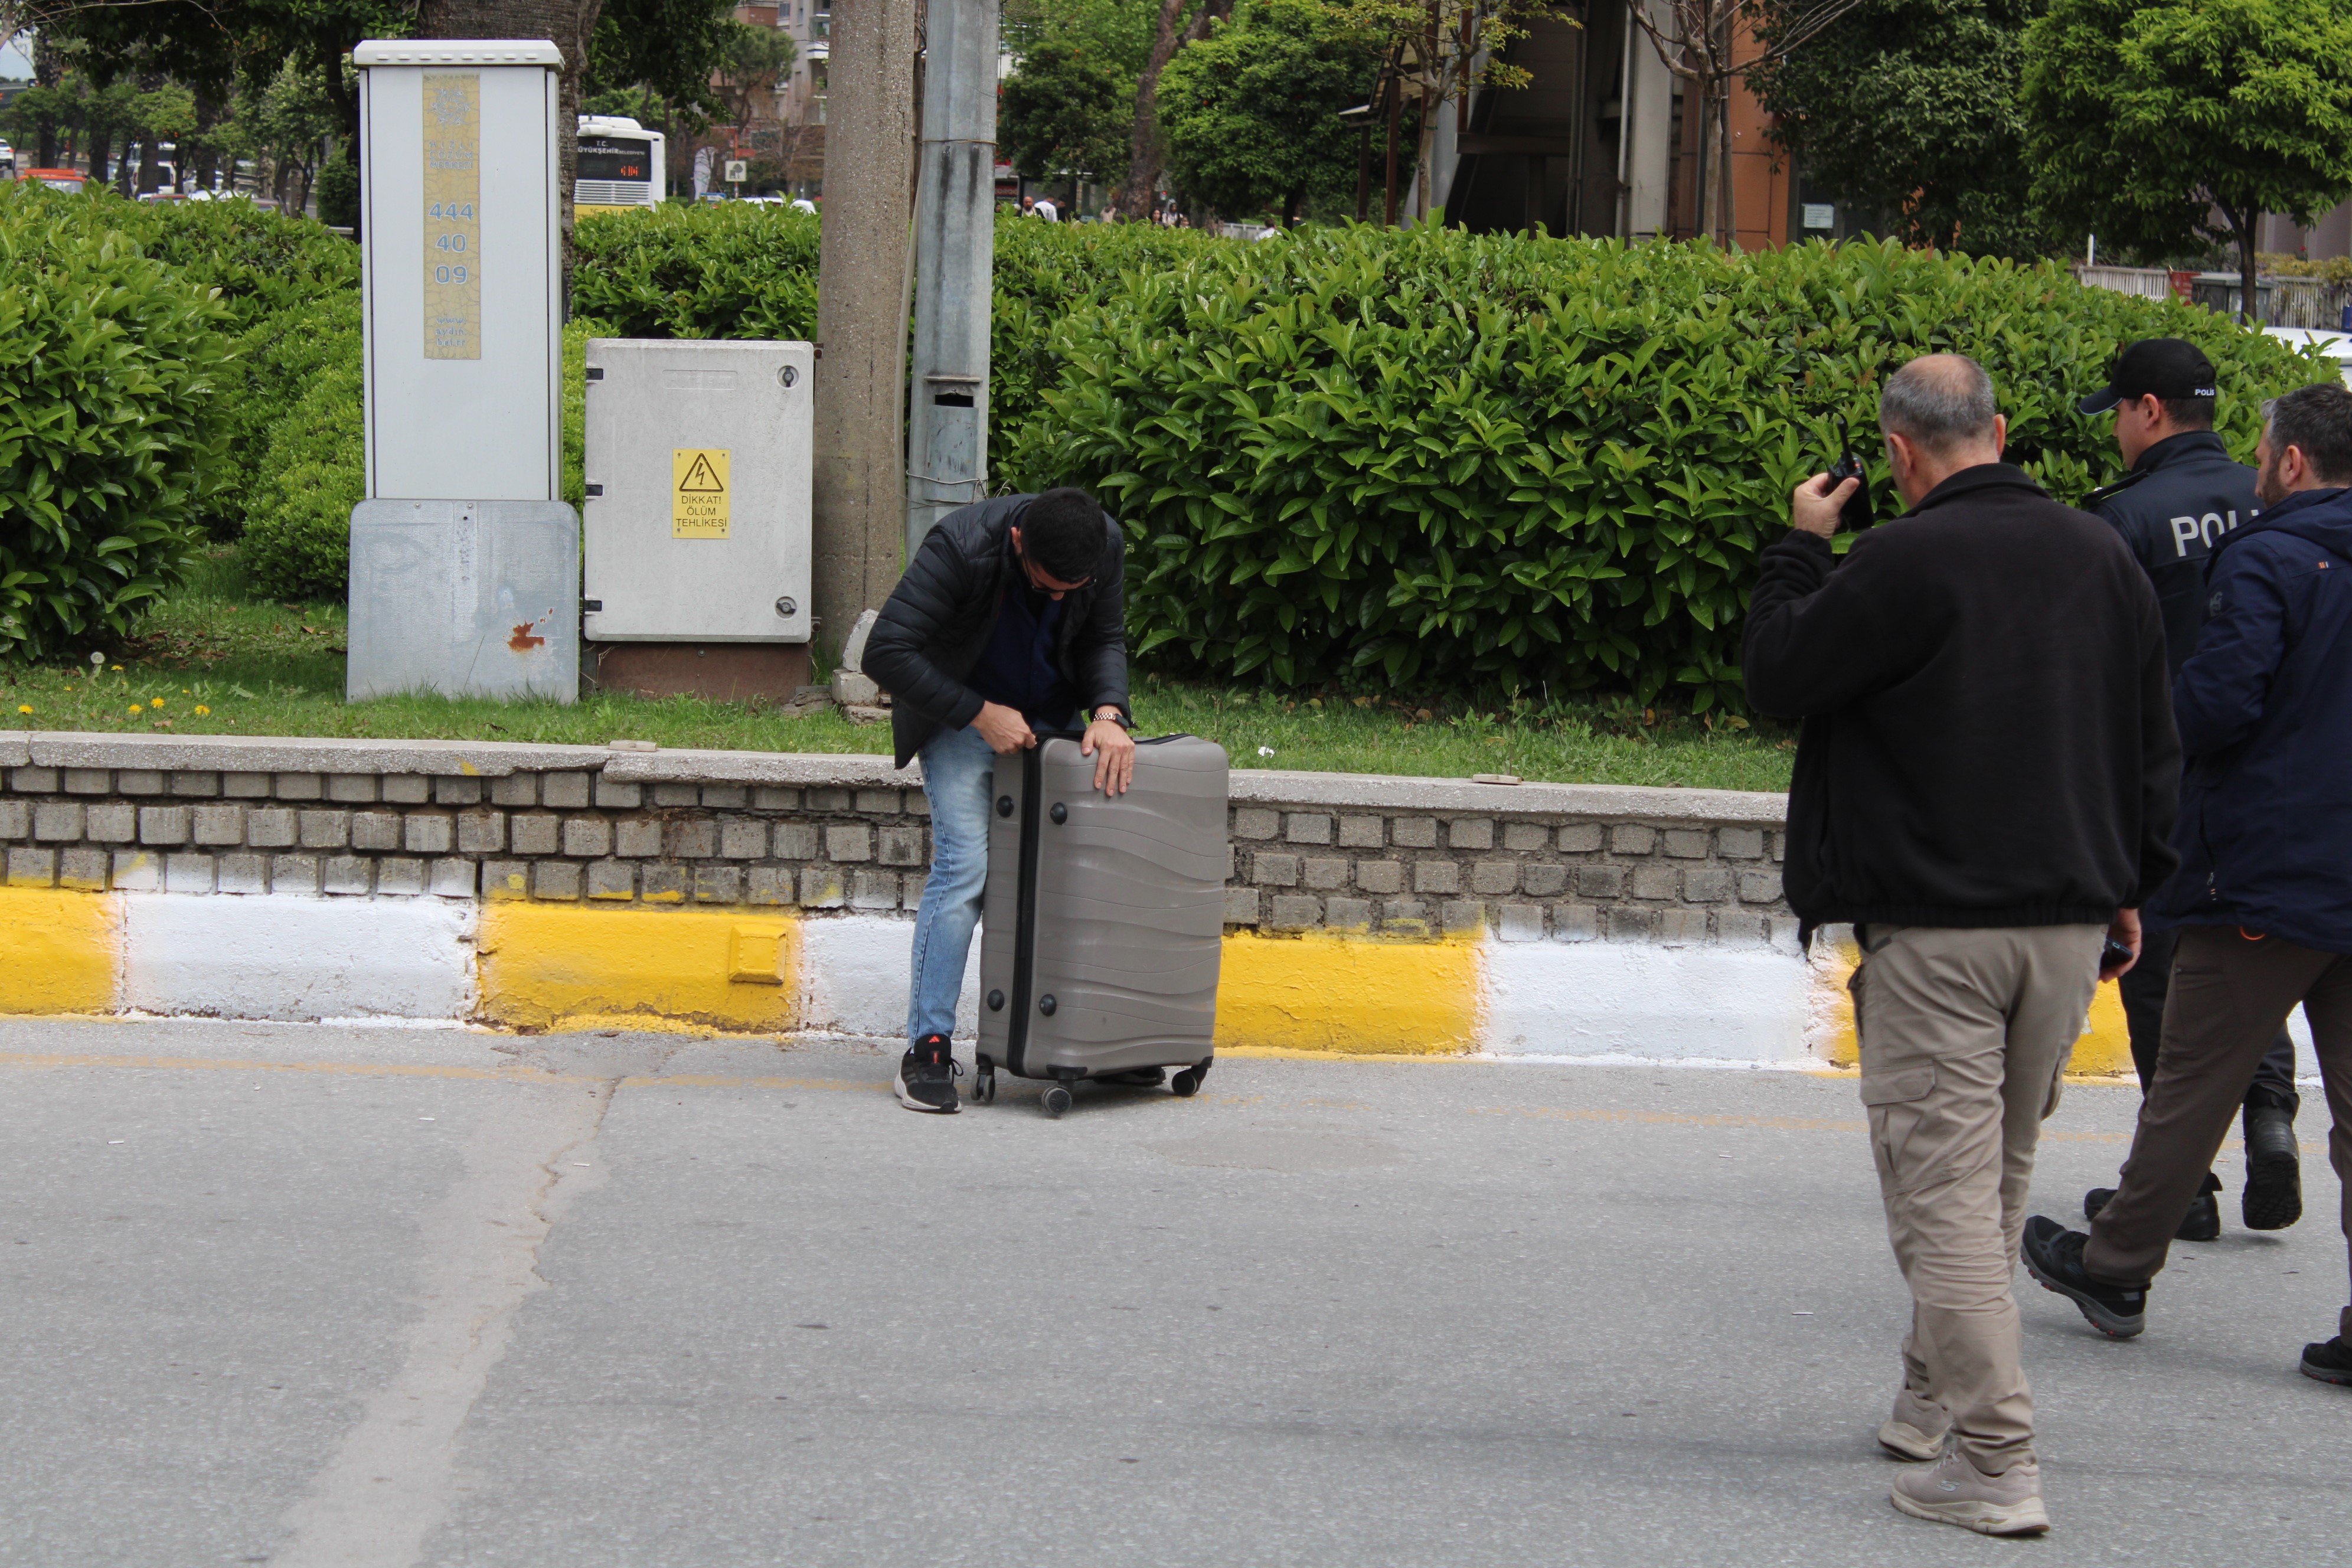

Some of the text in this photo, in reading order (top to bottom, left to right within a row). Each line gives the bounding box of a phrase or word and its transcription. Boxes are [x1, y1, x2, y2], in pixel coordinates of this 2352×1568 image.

[428, 202, 473, 221] 444
[435, 233, 466, 253] 40
[435, 265, 468, 284] 09
[2195, 388, 2215, 396] POLİS
[681, 494, 721, 504] DİKKAT!
[687, 505, 716, 515] ÖLÜM
[675, 517, 727, 527] TEHLİKESİ
